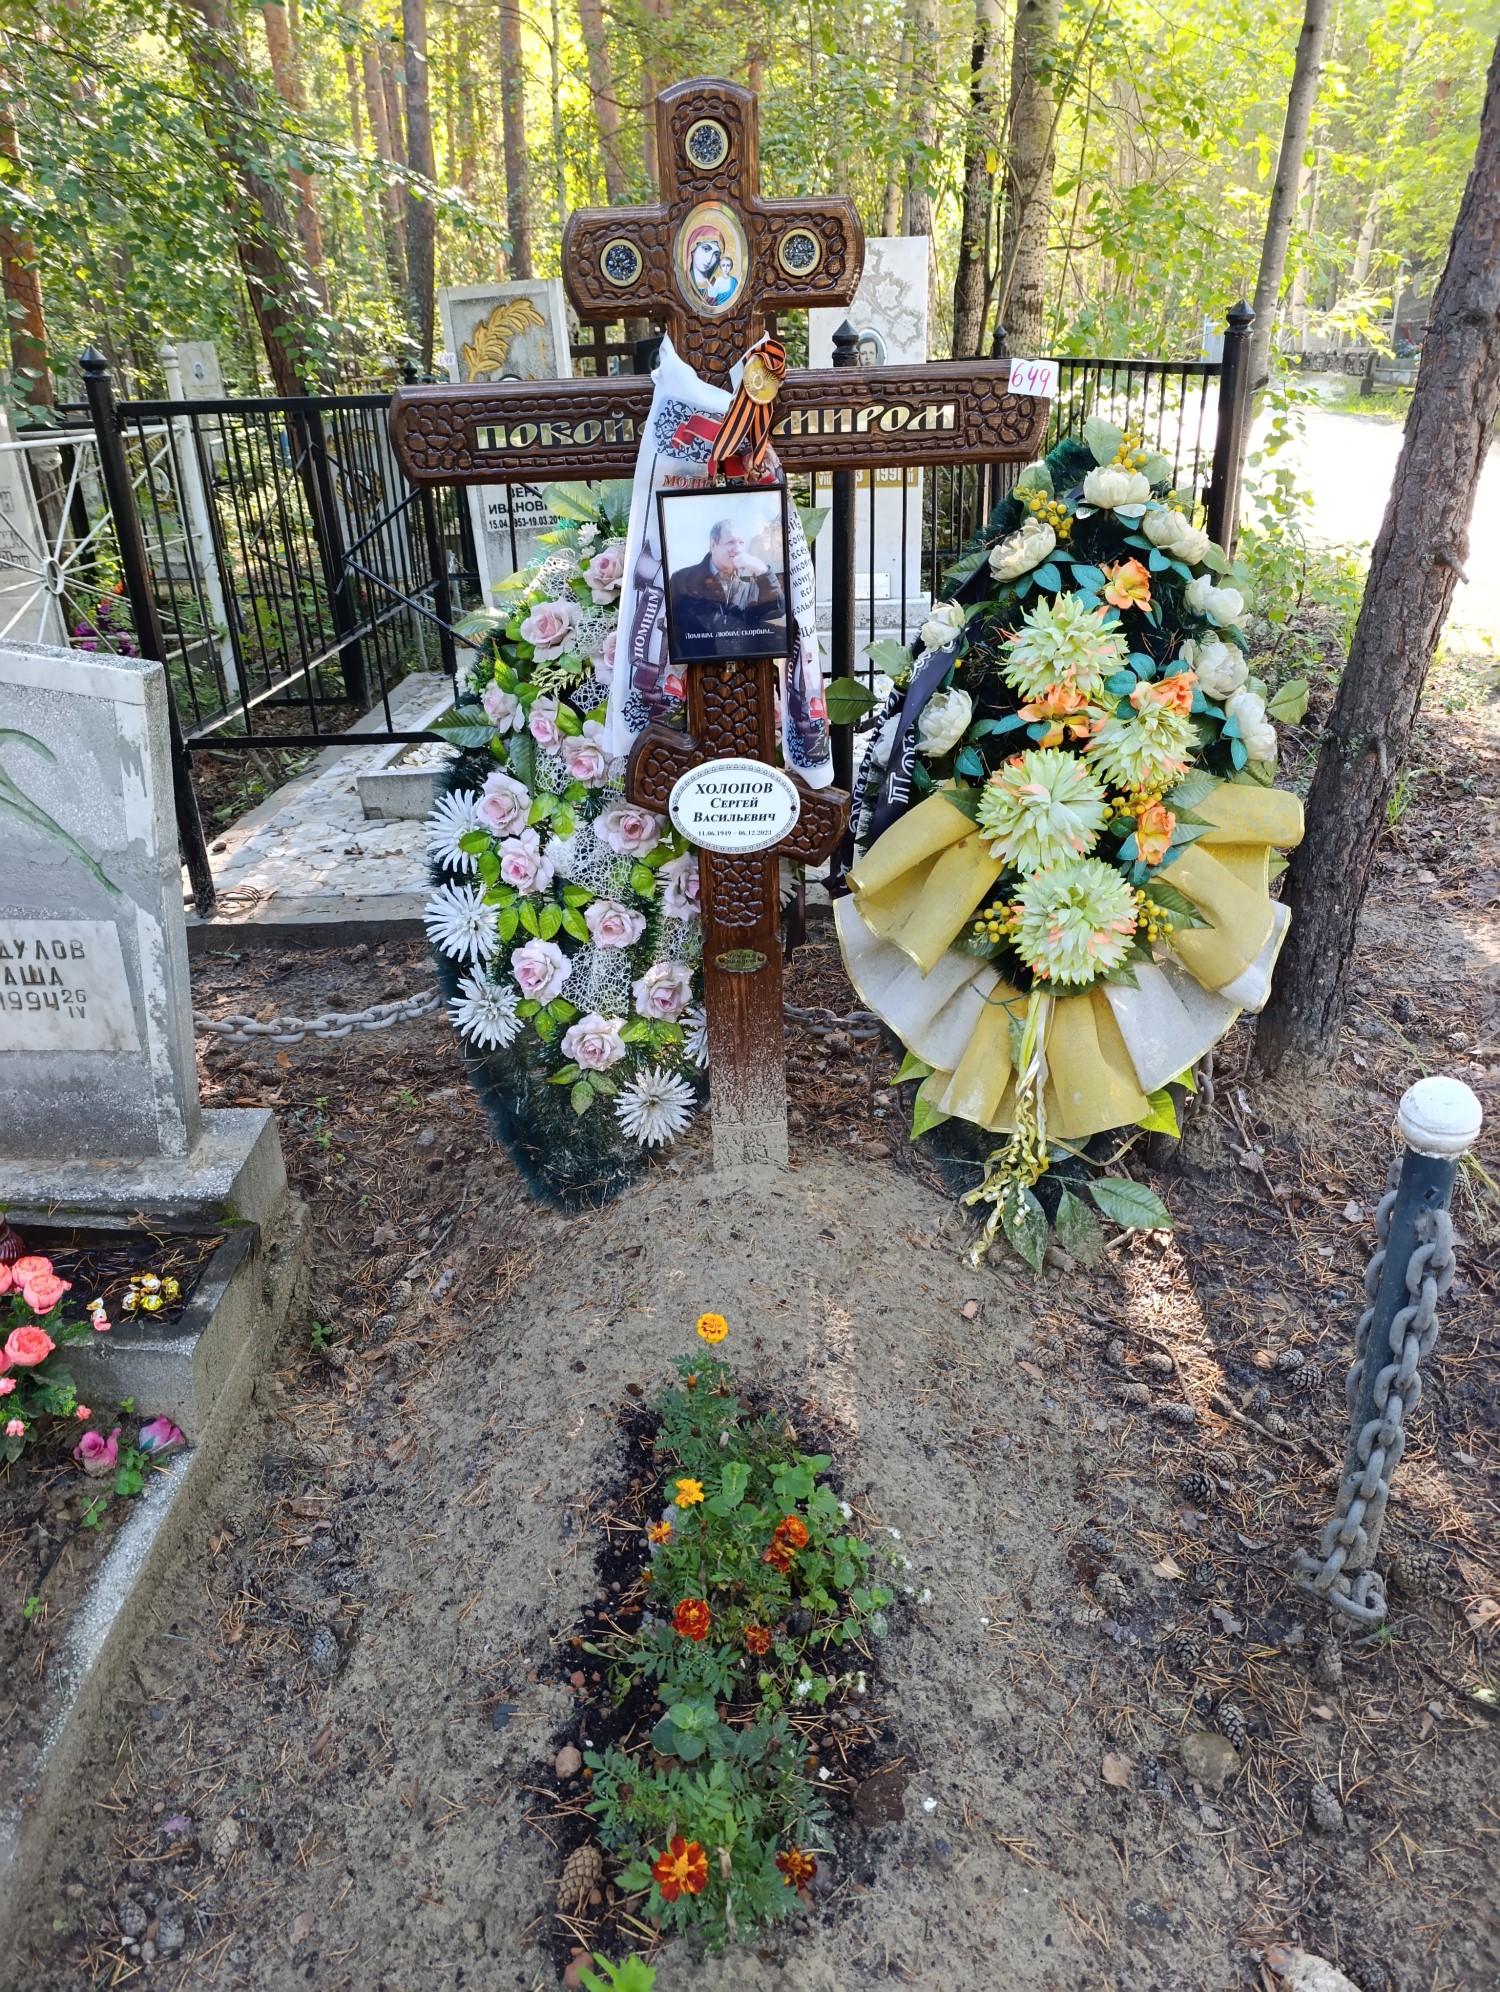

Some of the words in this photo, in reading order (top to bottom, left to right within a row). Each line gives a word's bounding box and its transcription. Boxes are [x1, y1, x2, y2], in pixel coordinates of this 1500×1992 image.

[1011, 362, 1051, 395] 649
[772, 404, 955, 435] МИРОМ
[634, 589, 660, 659] ПОМНИМ
[695, 782, 773, 795] ХОЛОПОВ
[61, 989, 87, 1004] 26
